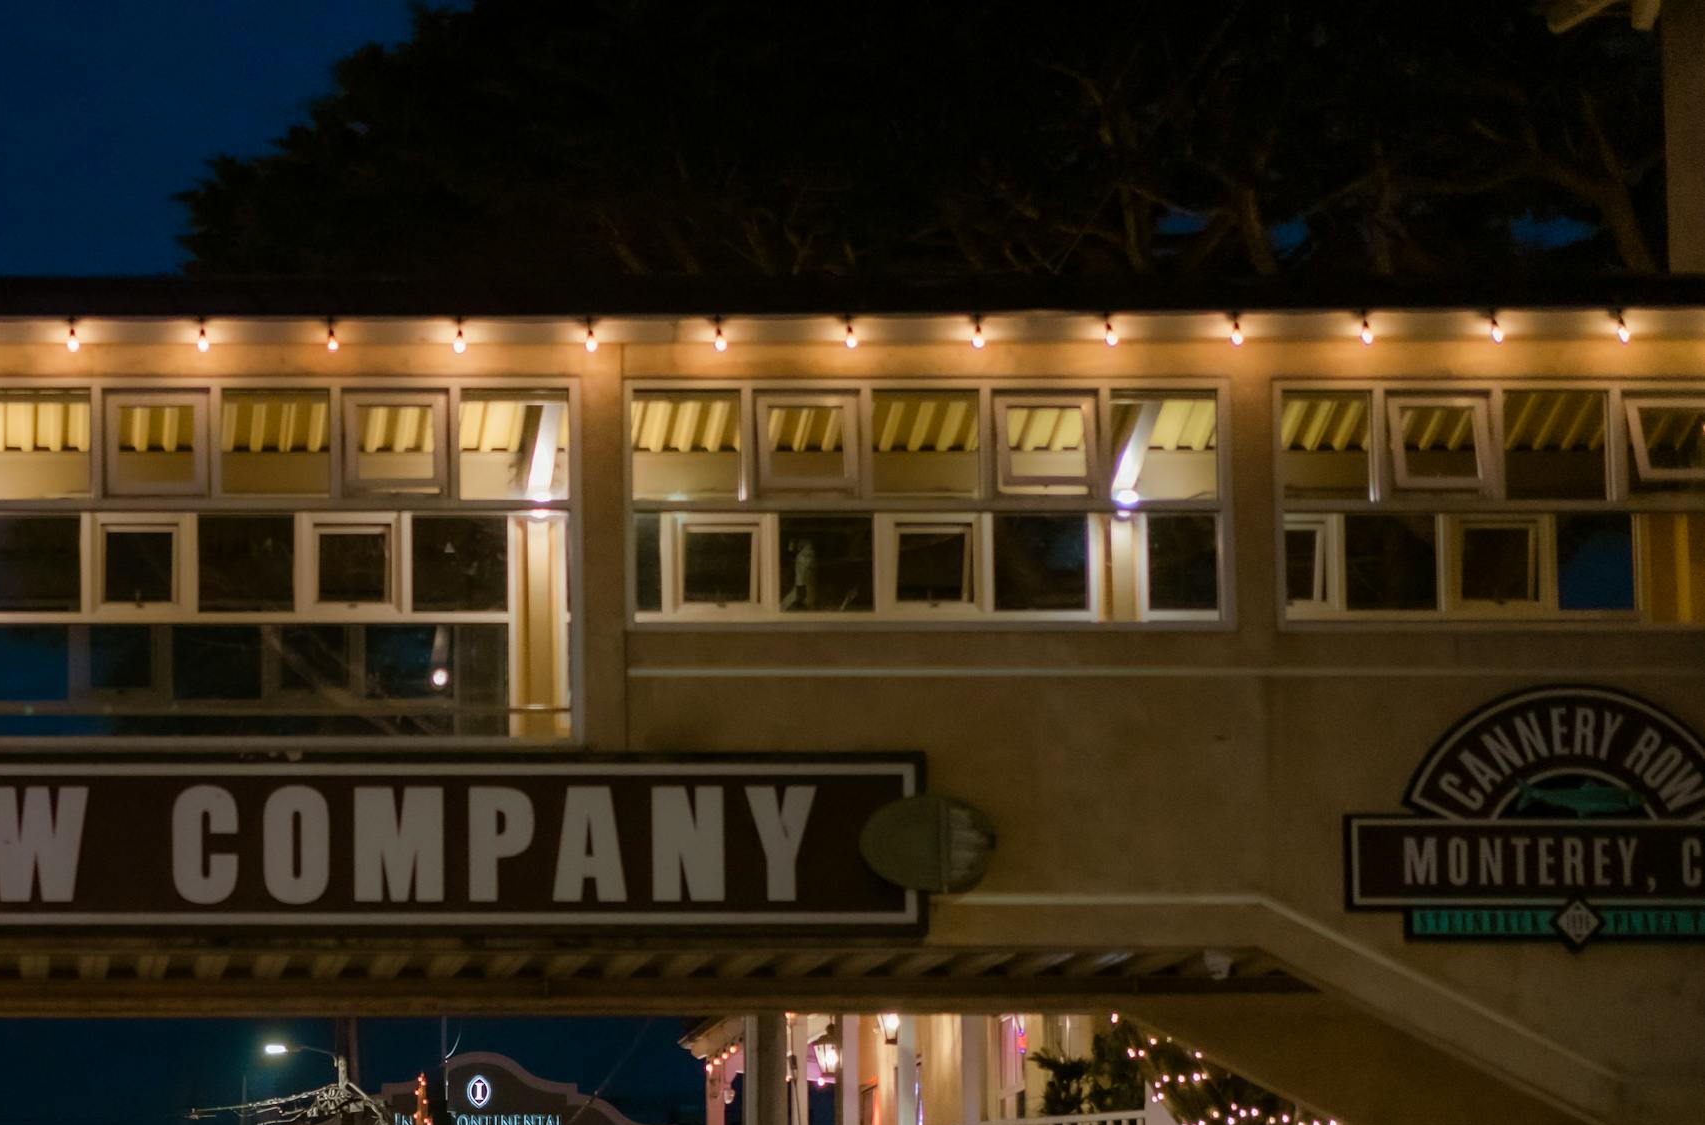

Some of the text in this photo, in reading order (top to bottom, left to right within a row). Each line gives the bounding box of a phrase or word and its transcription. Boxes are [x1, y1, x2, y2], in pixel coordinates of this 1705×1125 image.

[1439, 708, 1705, 812] CANNERY ROW
[171, 785, 818, 904] COMPANY
[1403, 836, 1705, 893] MONTEREY, C
